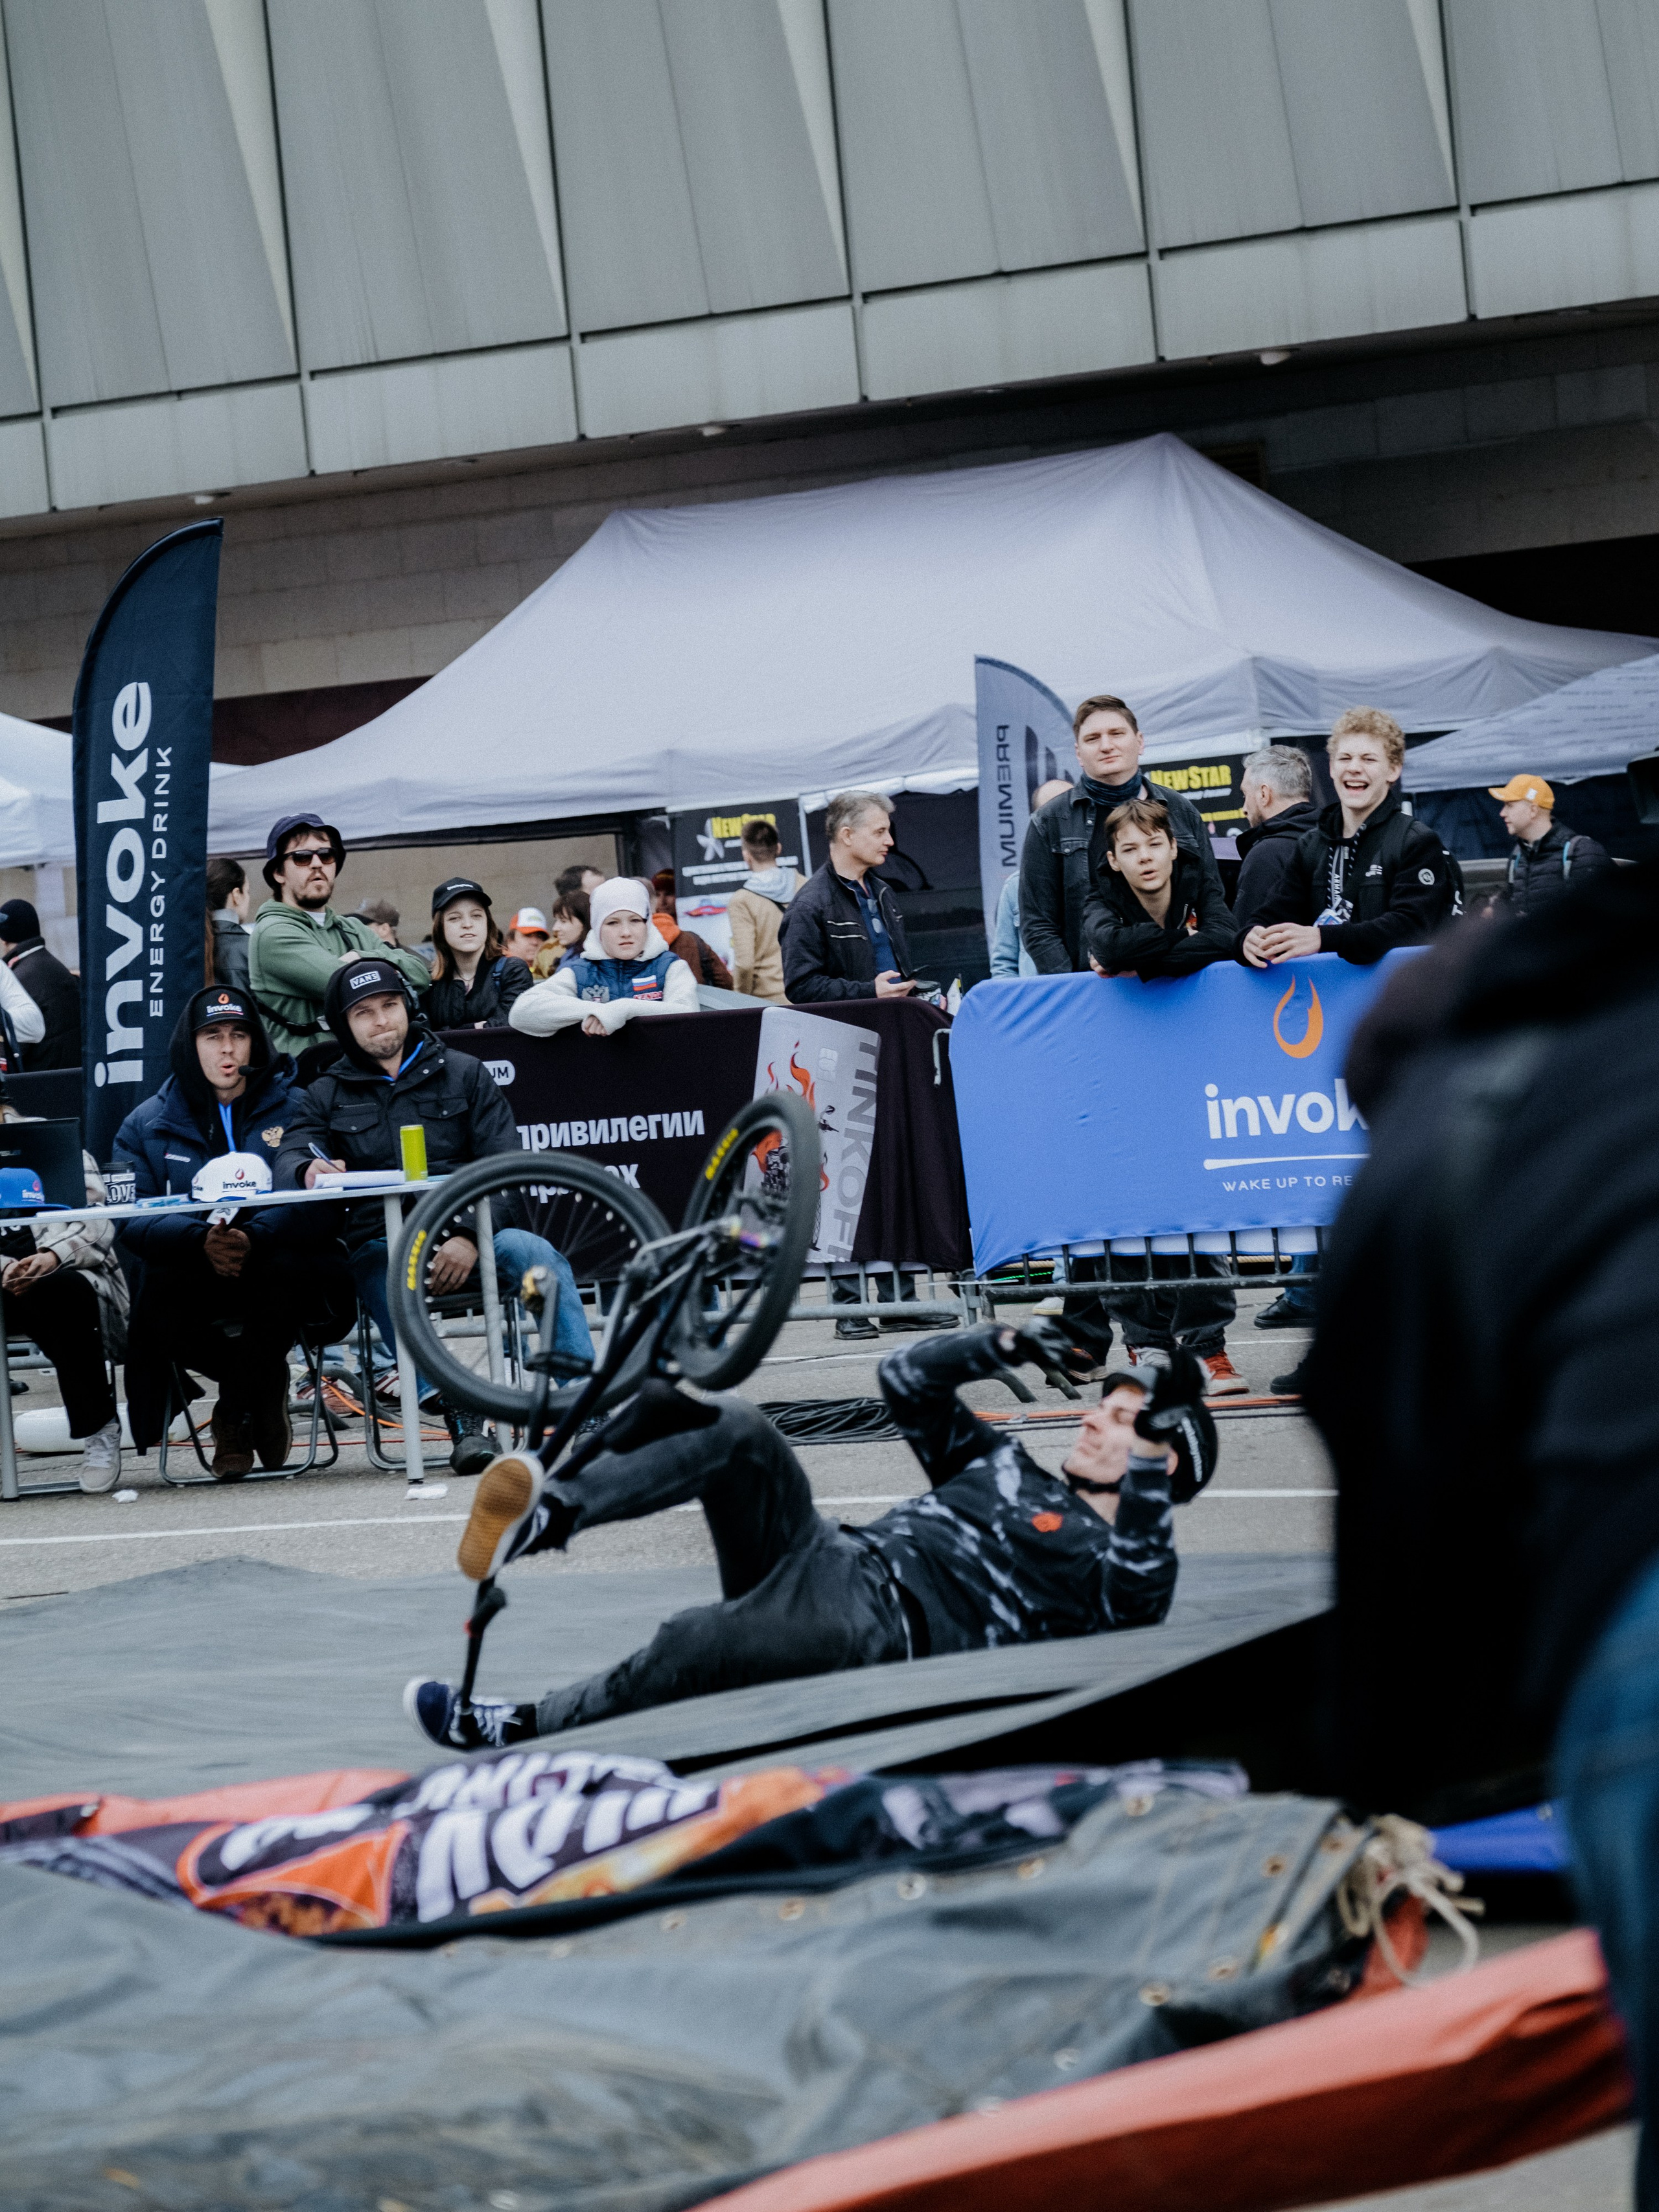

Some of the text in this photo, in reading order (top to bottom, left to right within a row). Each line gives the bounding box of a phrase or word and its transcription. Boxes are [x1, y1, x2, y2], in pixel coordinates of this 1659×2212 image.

[95, 682, 152, 1087] invoke
[150, 747, 172, 1017] ENERGY DRINK
[353, 972, 378, 984] VANS
[206, 1004, 242, 1014] invoke
[222, 1181, 257, 1190] invoke
[1222, 1178, 1271, 1192] WAKE
[1276, 1177, 1298, 1188] UP
[1304, 1176, 1327, 1187] TO
